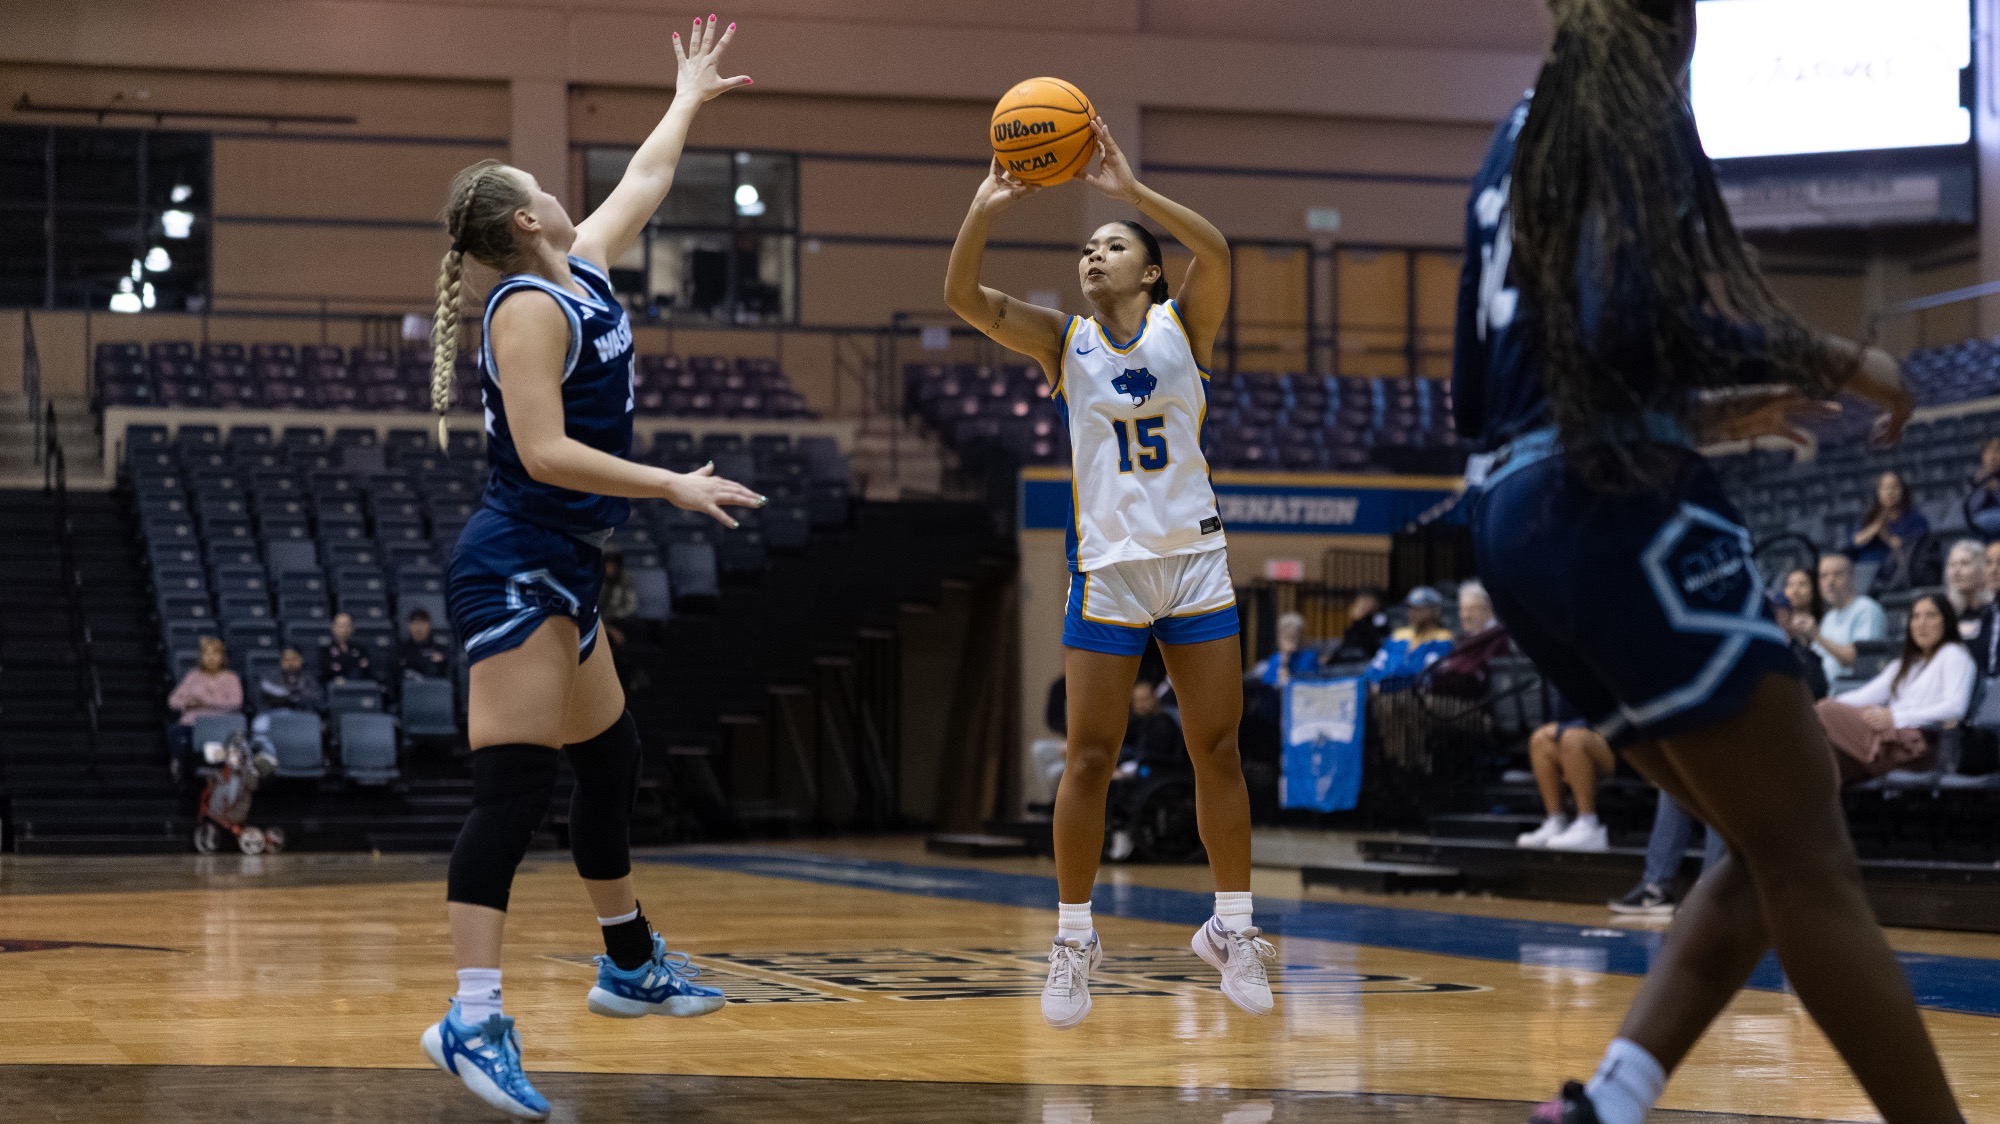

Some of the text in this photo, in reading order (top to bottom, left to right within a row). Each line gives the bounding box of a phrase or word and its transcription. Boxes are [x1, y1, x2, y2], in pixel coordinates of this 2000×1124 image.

[994, 119, 1057, 142] Wilson
[1008, 151, 1059, 172] NCAA
[1111, 413, 1170, 475] 15
